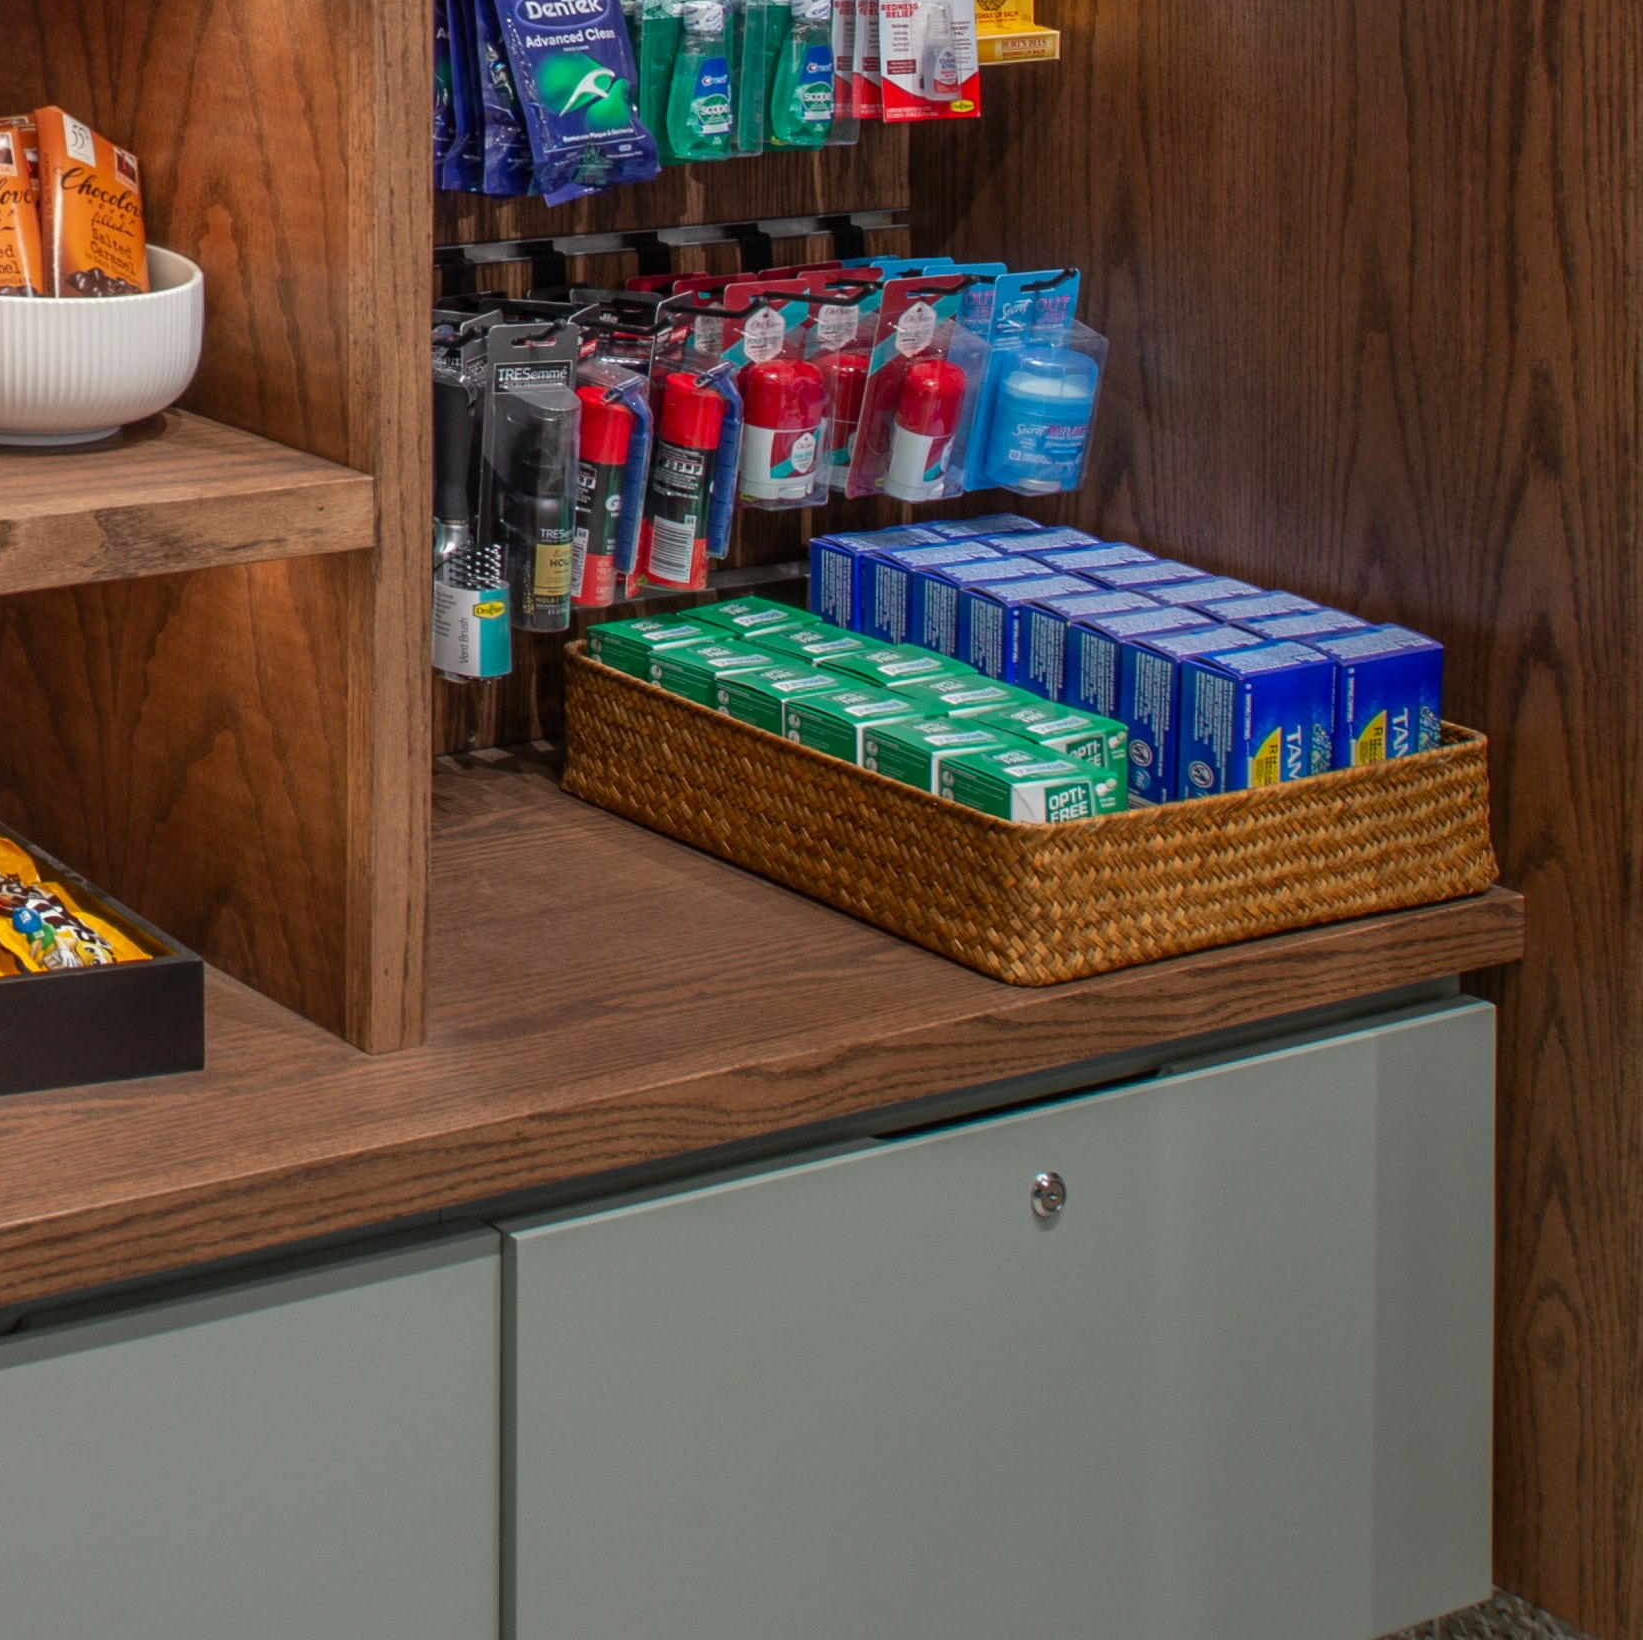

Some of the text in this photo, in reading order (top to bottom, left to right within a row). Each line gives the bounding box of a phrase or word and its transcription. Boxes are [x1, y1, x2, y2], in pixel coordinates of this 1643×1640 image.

[881, 2, 919, 12] REDNESS
[886, 10, 914, 19] RELIEF
[524, 27, 615, 50] Advanced Clean
[807, 63, 832, 73] Crest
[701, 75, 728, 86] Crest
[804, 92, 832, 103] scope
[92, 228, 133, 258] Salted
[90, 242, 137, 276] Caramel
[1012, 422, 1049, 438] Secret
[1049, 786, 1086, 810] OPTI-
